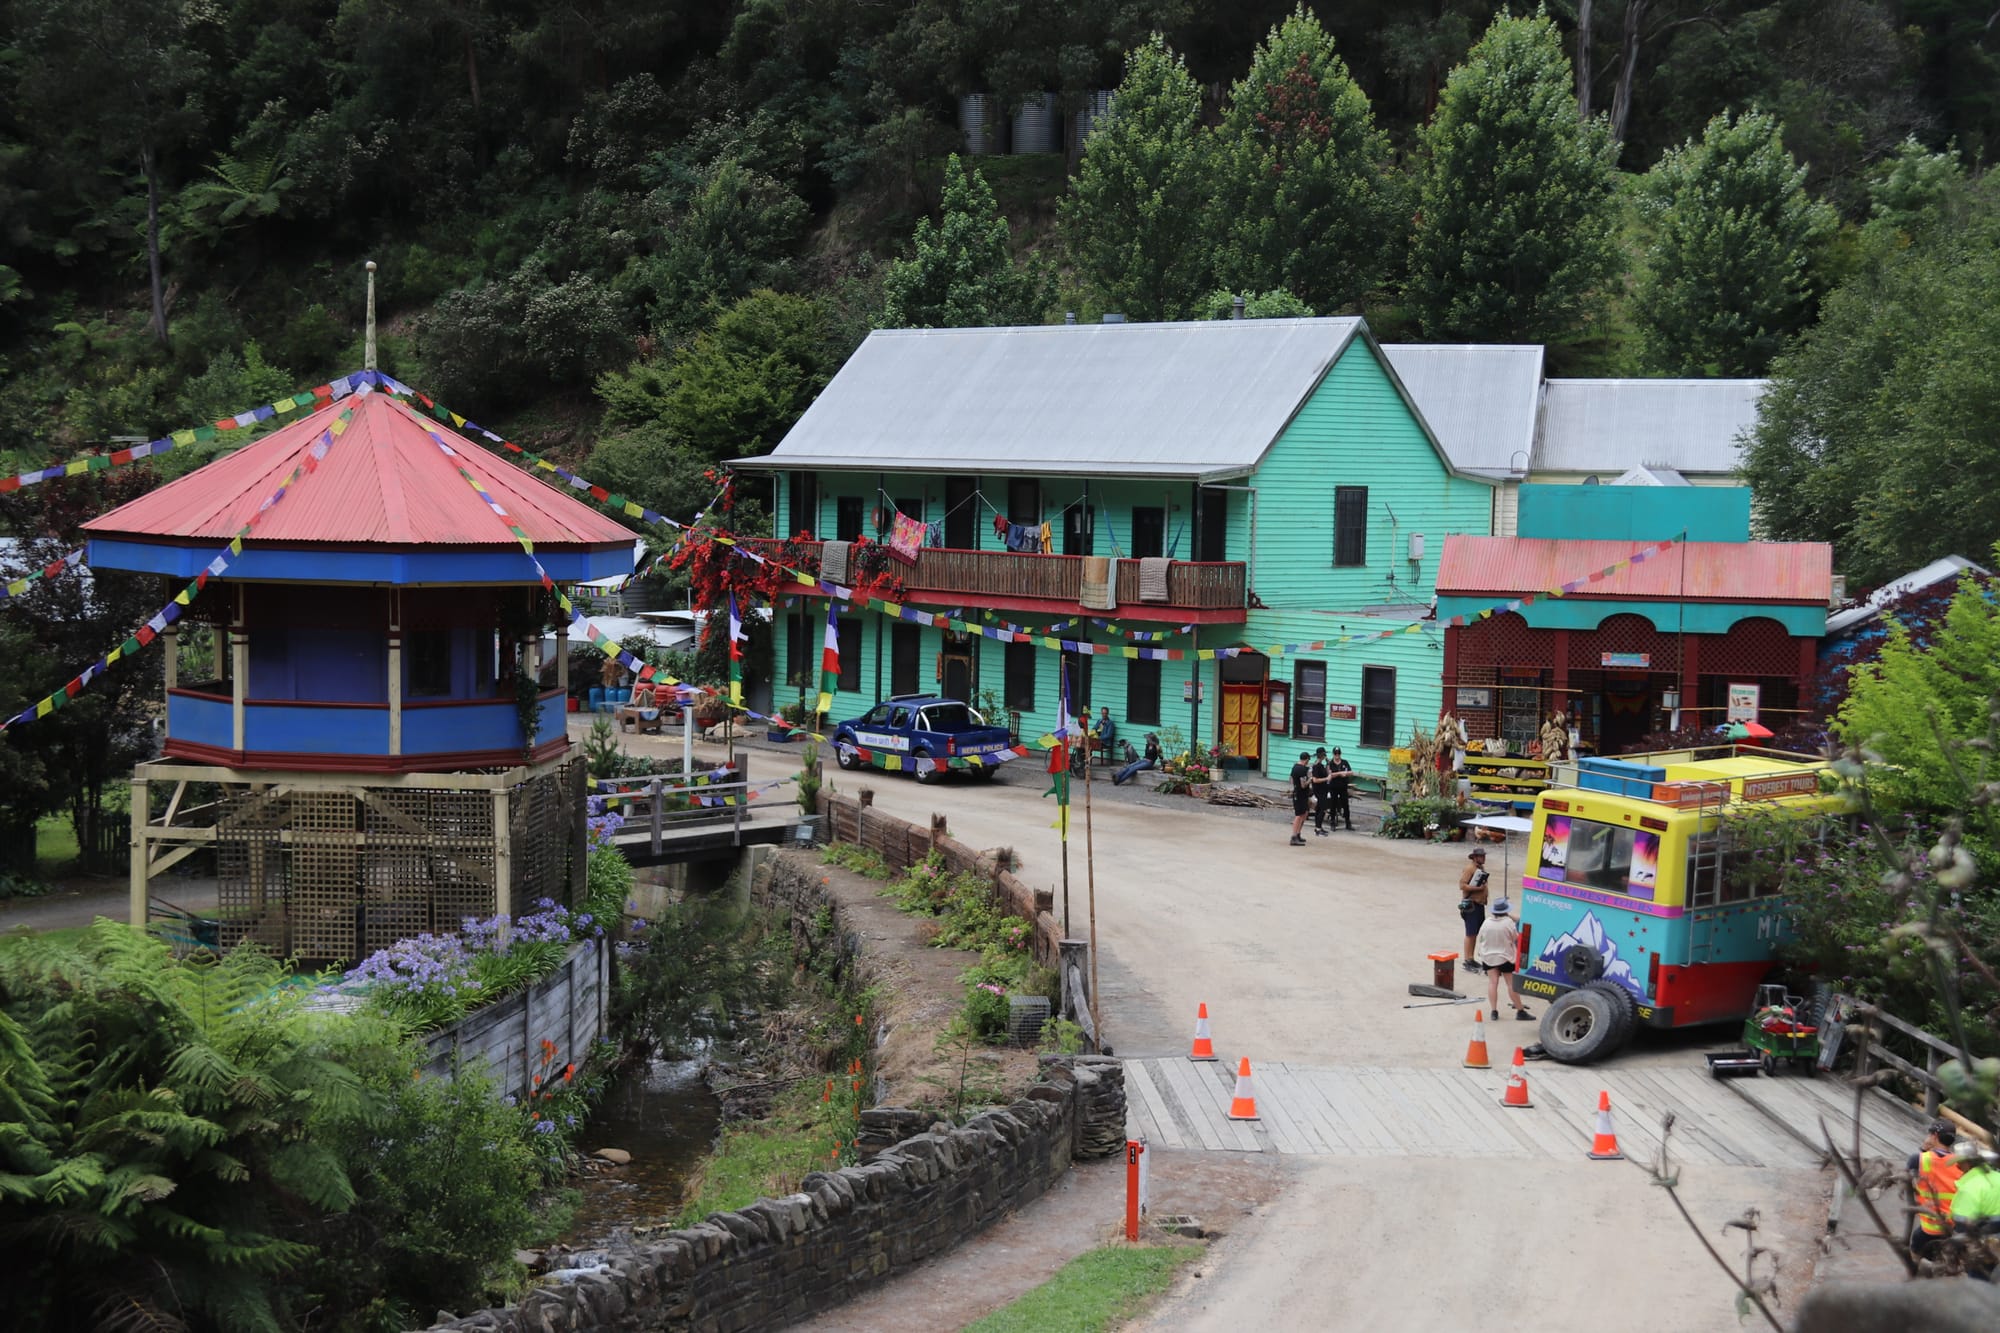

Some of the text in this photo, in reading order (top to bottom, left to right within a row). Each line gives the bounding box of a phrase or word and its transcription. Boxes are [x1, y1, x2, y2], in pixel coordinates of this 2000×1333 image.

[961, 743, 1004, 755] NEPAL POLICE
[1758, 780, 1789, 795] EVEREST
[1790, 777, 1814, 791] TOURS
[1535, 881, 1653, 912] MT EVEREST TOURS
[1523, 980, 1556, 996] HORN
